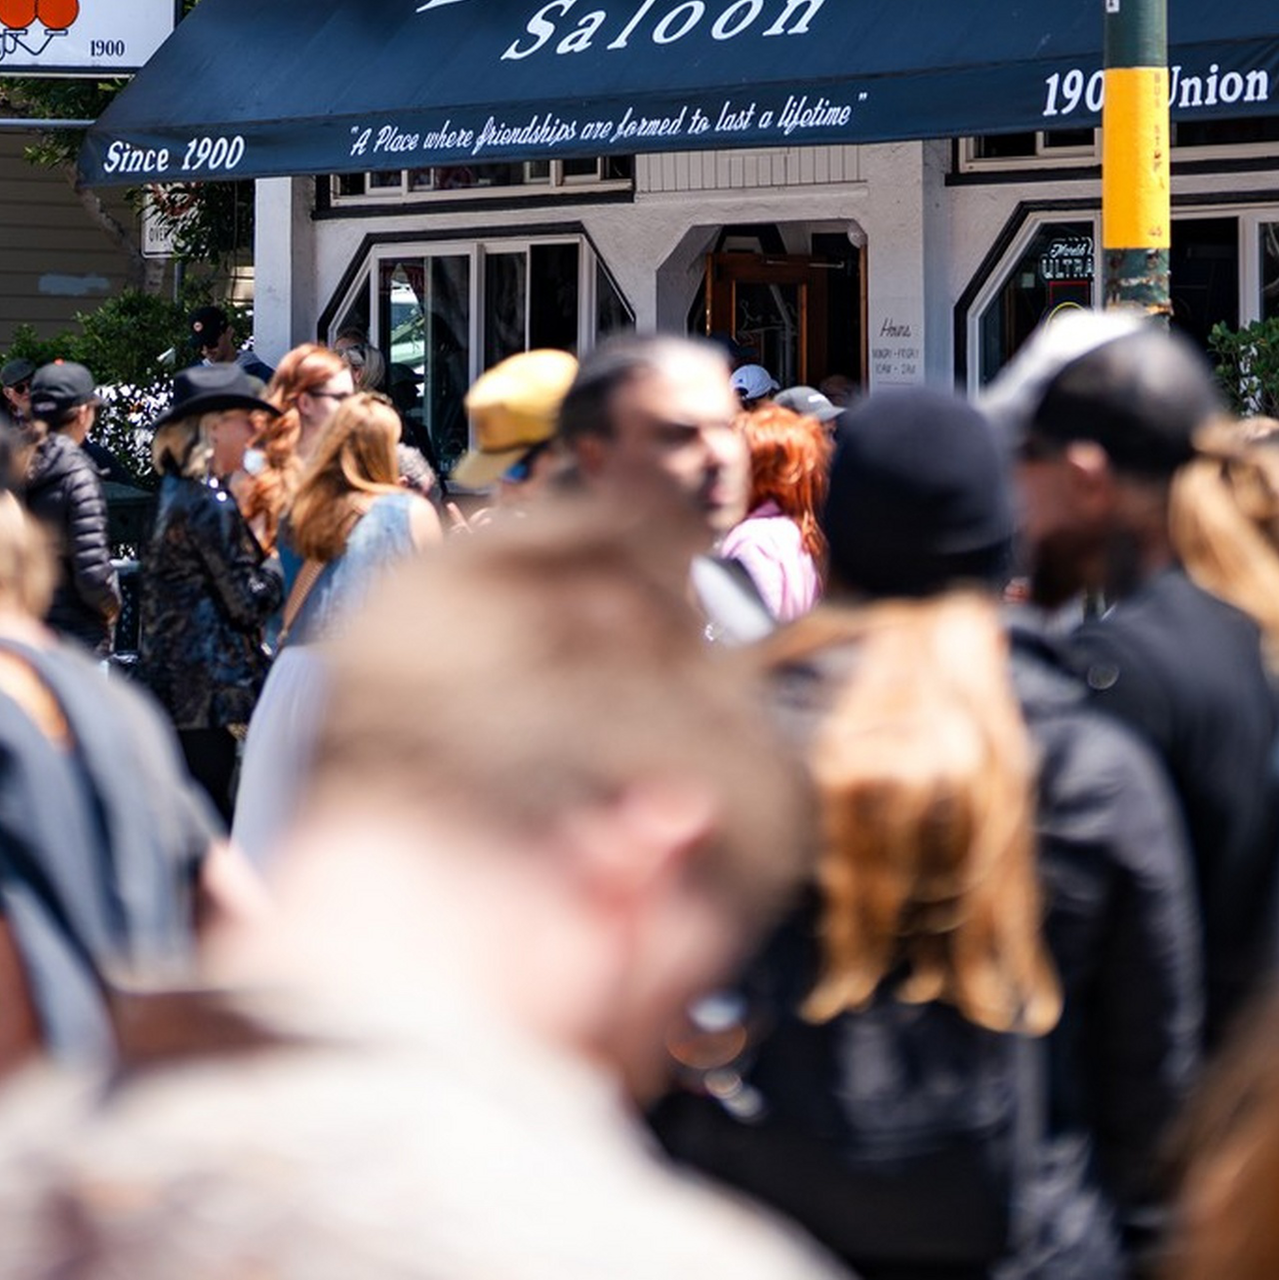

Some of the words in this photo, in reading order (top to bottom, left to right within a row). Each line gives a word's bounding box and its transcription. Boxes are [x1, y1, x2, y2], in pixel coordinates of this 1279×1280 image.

[90, 40, 125, 56] 1900
[1042, 69, 1105, 116] 190
[373, 125, 418, 152] Place
[423, 120, 473, 149] where
[471, 114, 577, 155] friendships
[580, 120, 612, 140] are
[610, 107, 687, 143] formed
[687, 108, 710, 134] to
[714, 101, 756, 131] last
[758, 110, 773, 129] a
[103, 140, 169, 172] Since
[181, 135, 245, 170] 1900
[1042, 258, 1096, 279] ULTRA
